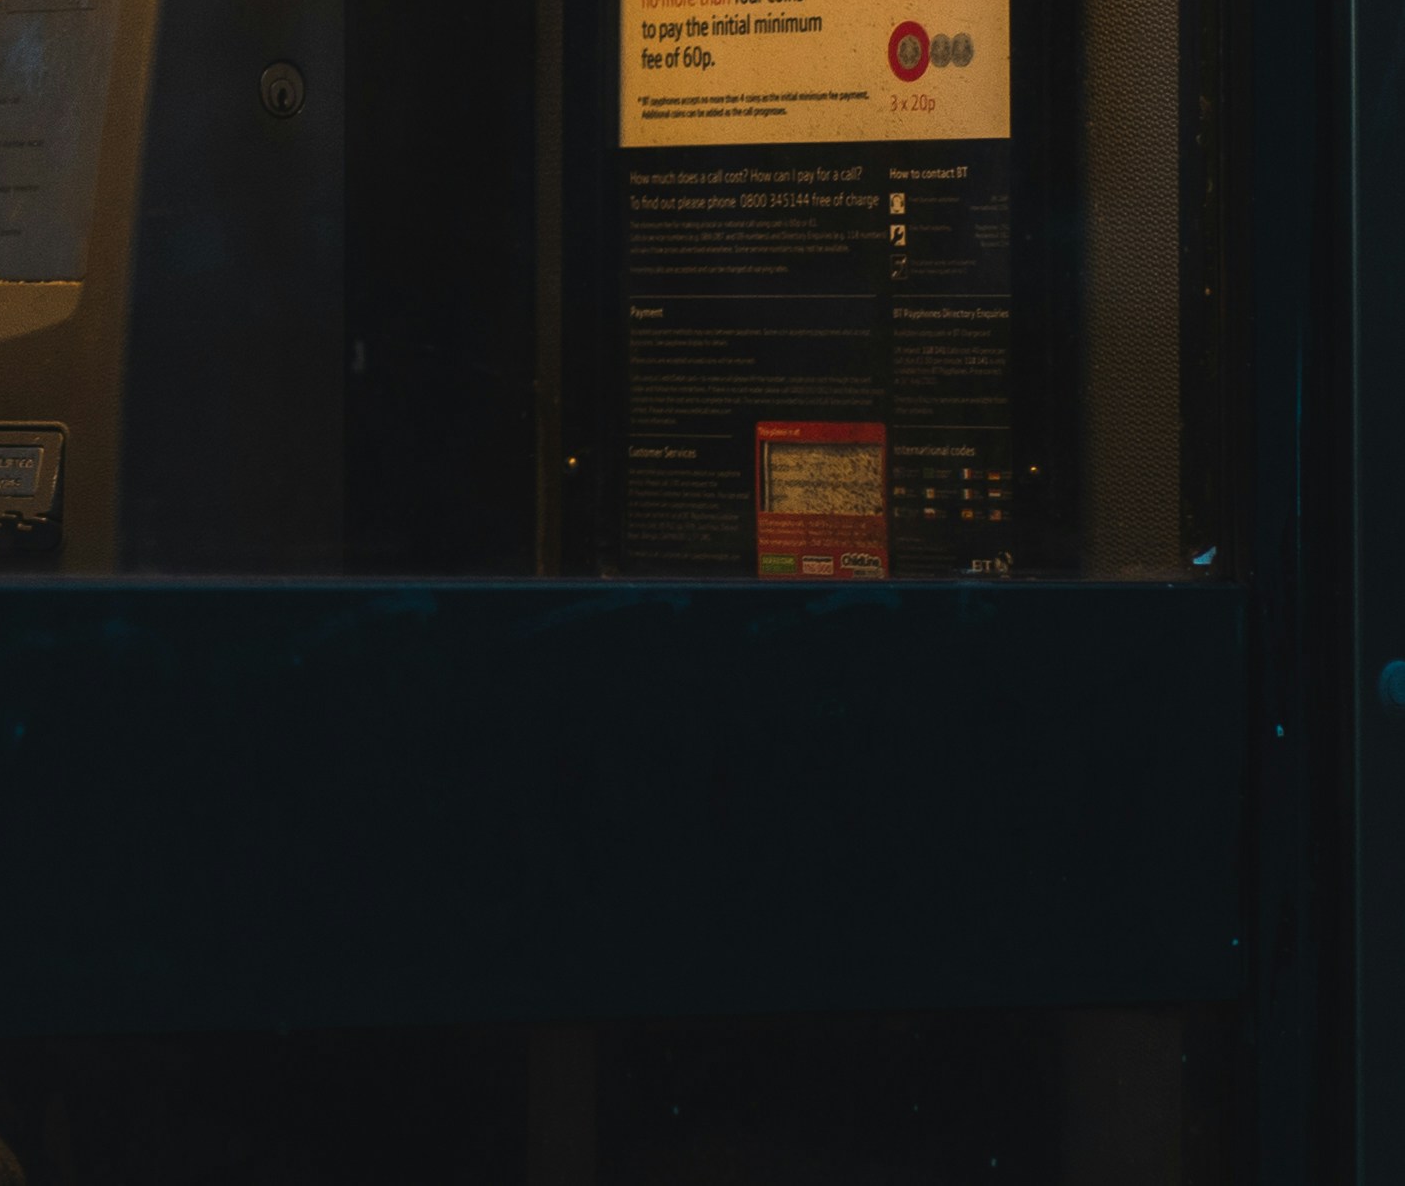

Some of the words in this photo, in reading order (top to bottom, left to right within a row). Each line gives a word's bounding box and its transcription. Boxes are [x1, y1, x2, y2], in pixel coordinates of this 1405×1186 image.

[642, 21, 657, 40] to
[659, 21, 684, 44] pay
[686, 17, 709, 37] the
[711, 13, 751, 36] initial
[754, 11, 823, 34] minimum
[641, 49, 663, 69] fee
[665, 46, 680, 68] of
[683, 45, 716, 71] 60p.
[911, 93, 936, 114] 20p
[630, 170, 650, 186] How
[652, 170, 676, 185] much
[677, 168, 699, 184] does
[707, 167, 723, 183] call
[724, 167, 749, 184] cost?
[750, 167, 772, 183] How
[773, 170, 791, 182] can
[797, 170, 815, 185] pay
[816, 165, 831, 182] for
[840, 164, 864, 182] call?
[889, 167, 909, 180] How
[910, 168, 920, 180] to
[921, 168, 955, 180] contact
[956, 165, 969, 178] BT
[630, 195, 640, 210] To
[641, 193, 659, 211] find
[660, 196, 676, 210] out
[677, 194, 706, 213] please
[707, 194, 737, 212] phone
[740, 192, 767, 208] 0800
[811, 191, 831, 207] free
[832, 190, 845, 207] of
[845, 190, 880, 210] charge
[628, 445, 663, 459] Customer
[664, 444, 697, 459] Services
[971, 559, 993, 572] BT
